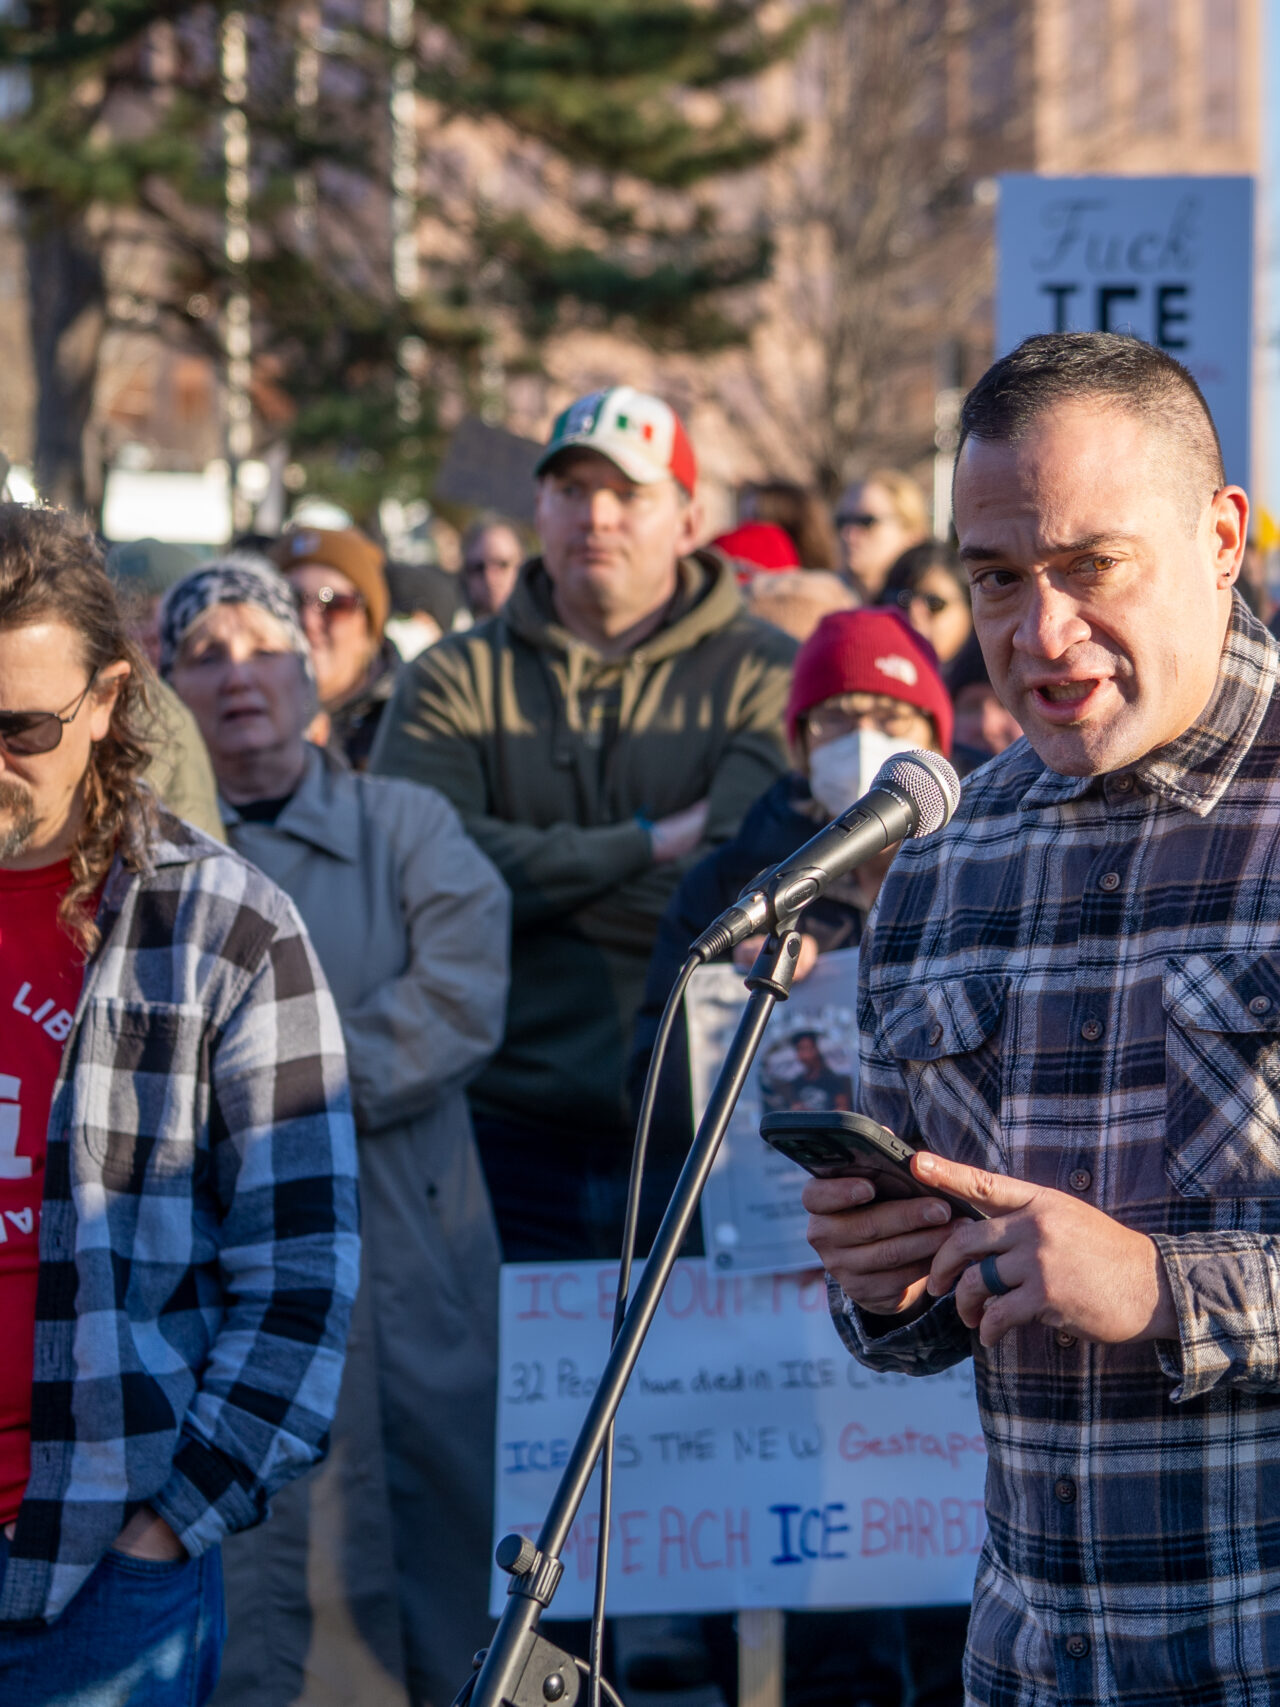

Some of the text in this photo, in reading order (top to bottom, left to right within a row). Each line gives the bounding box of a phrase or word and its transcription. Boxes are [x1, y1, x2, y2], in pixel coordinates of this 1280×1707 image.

[1030, 193, 1203, 275] Fuck
[515, 1269, 617, 1321] ICE
[506, 1359, 545, 1405] 32
[779, 1357, 837, 1390] ICE
[504, 1437, 572, 1474] ICE
[649, 1426, 717, 1466] THE
[733, 1421, 824, 1463] NEW
[768, 1502, 850, 1566] ICE
